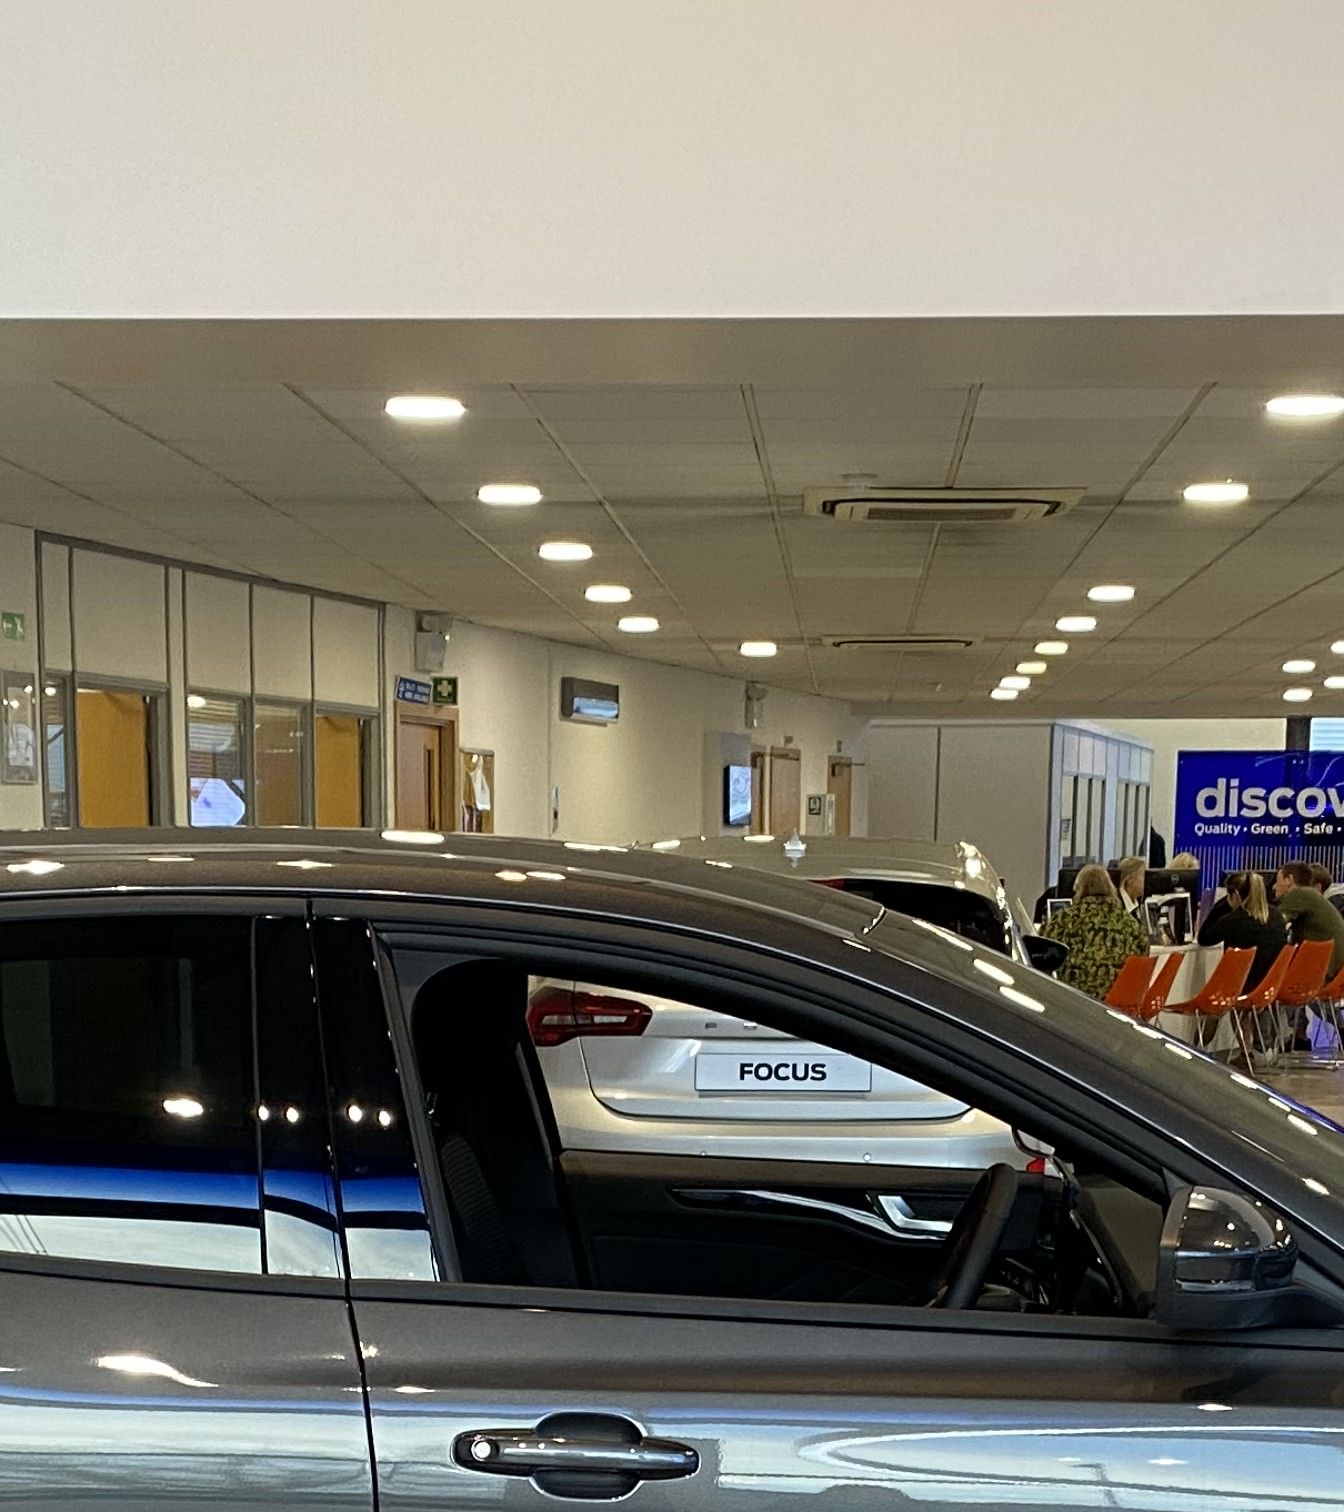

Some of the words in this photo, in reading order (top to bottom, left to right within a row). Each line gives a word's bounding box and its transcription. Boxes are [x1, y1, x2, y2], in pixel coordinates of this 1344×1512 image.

[1194, 822, 1241, 838] Quality
[1250, 822, 1289, 835] Green
[1303, 822, 1334, 835] Safe
[739, 1062, 827, 1081] FOCUS
